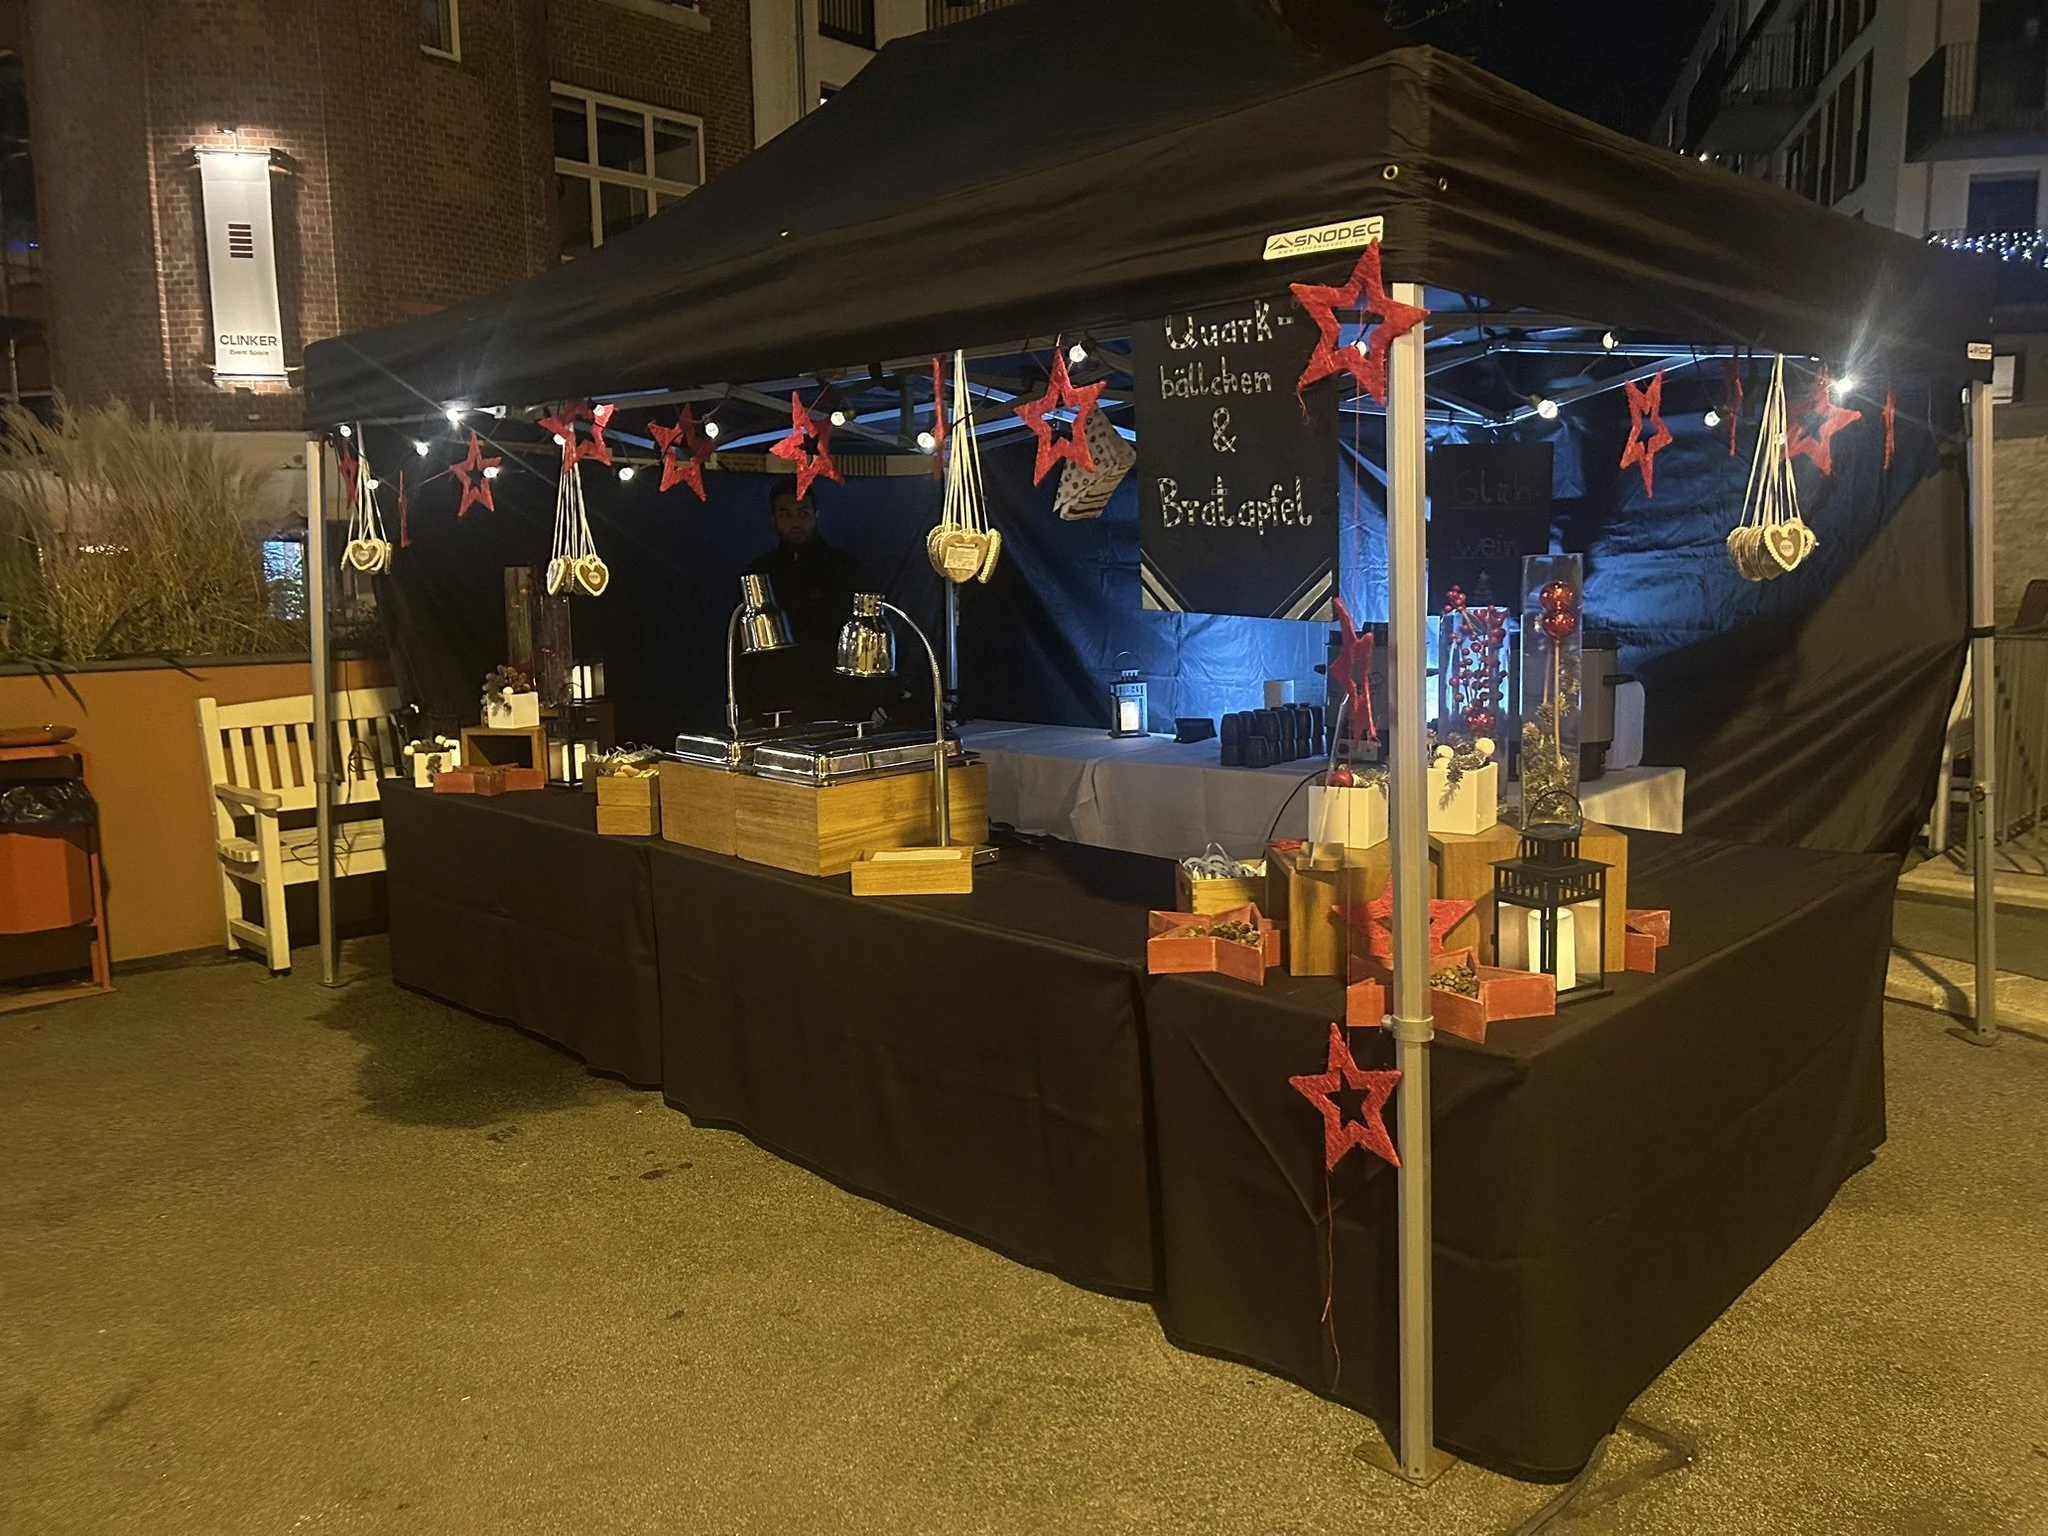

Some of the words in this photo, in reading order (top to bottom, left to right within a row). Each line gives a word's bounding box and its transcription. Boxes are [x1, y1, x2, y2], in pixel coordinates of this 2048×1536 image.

[1293, 221, 1381, 247] SNODEC
[219, 334, 278, 347] CLINKER
[1165, 300, 1295, 350] Quark-
[1160, 356, 1273, 400] bällchen
[1212, 406, 1238, 453] &
[1157, 475, 1313, 535] Bratapfel
